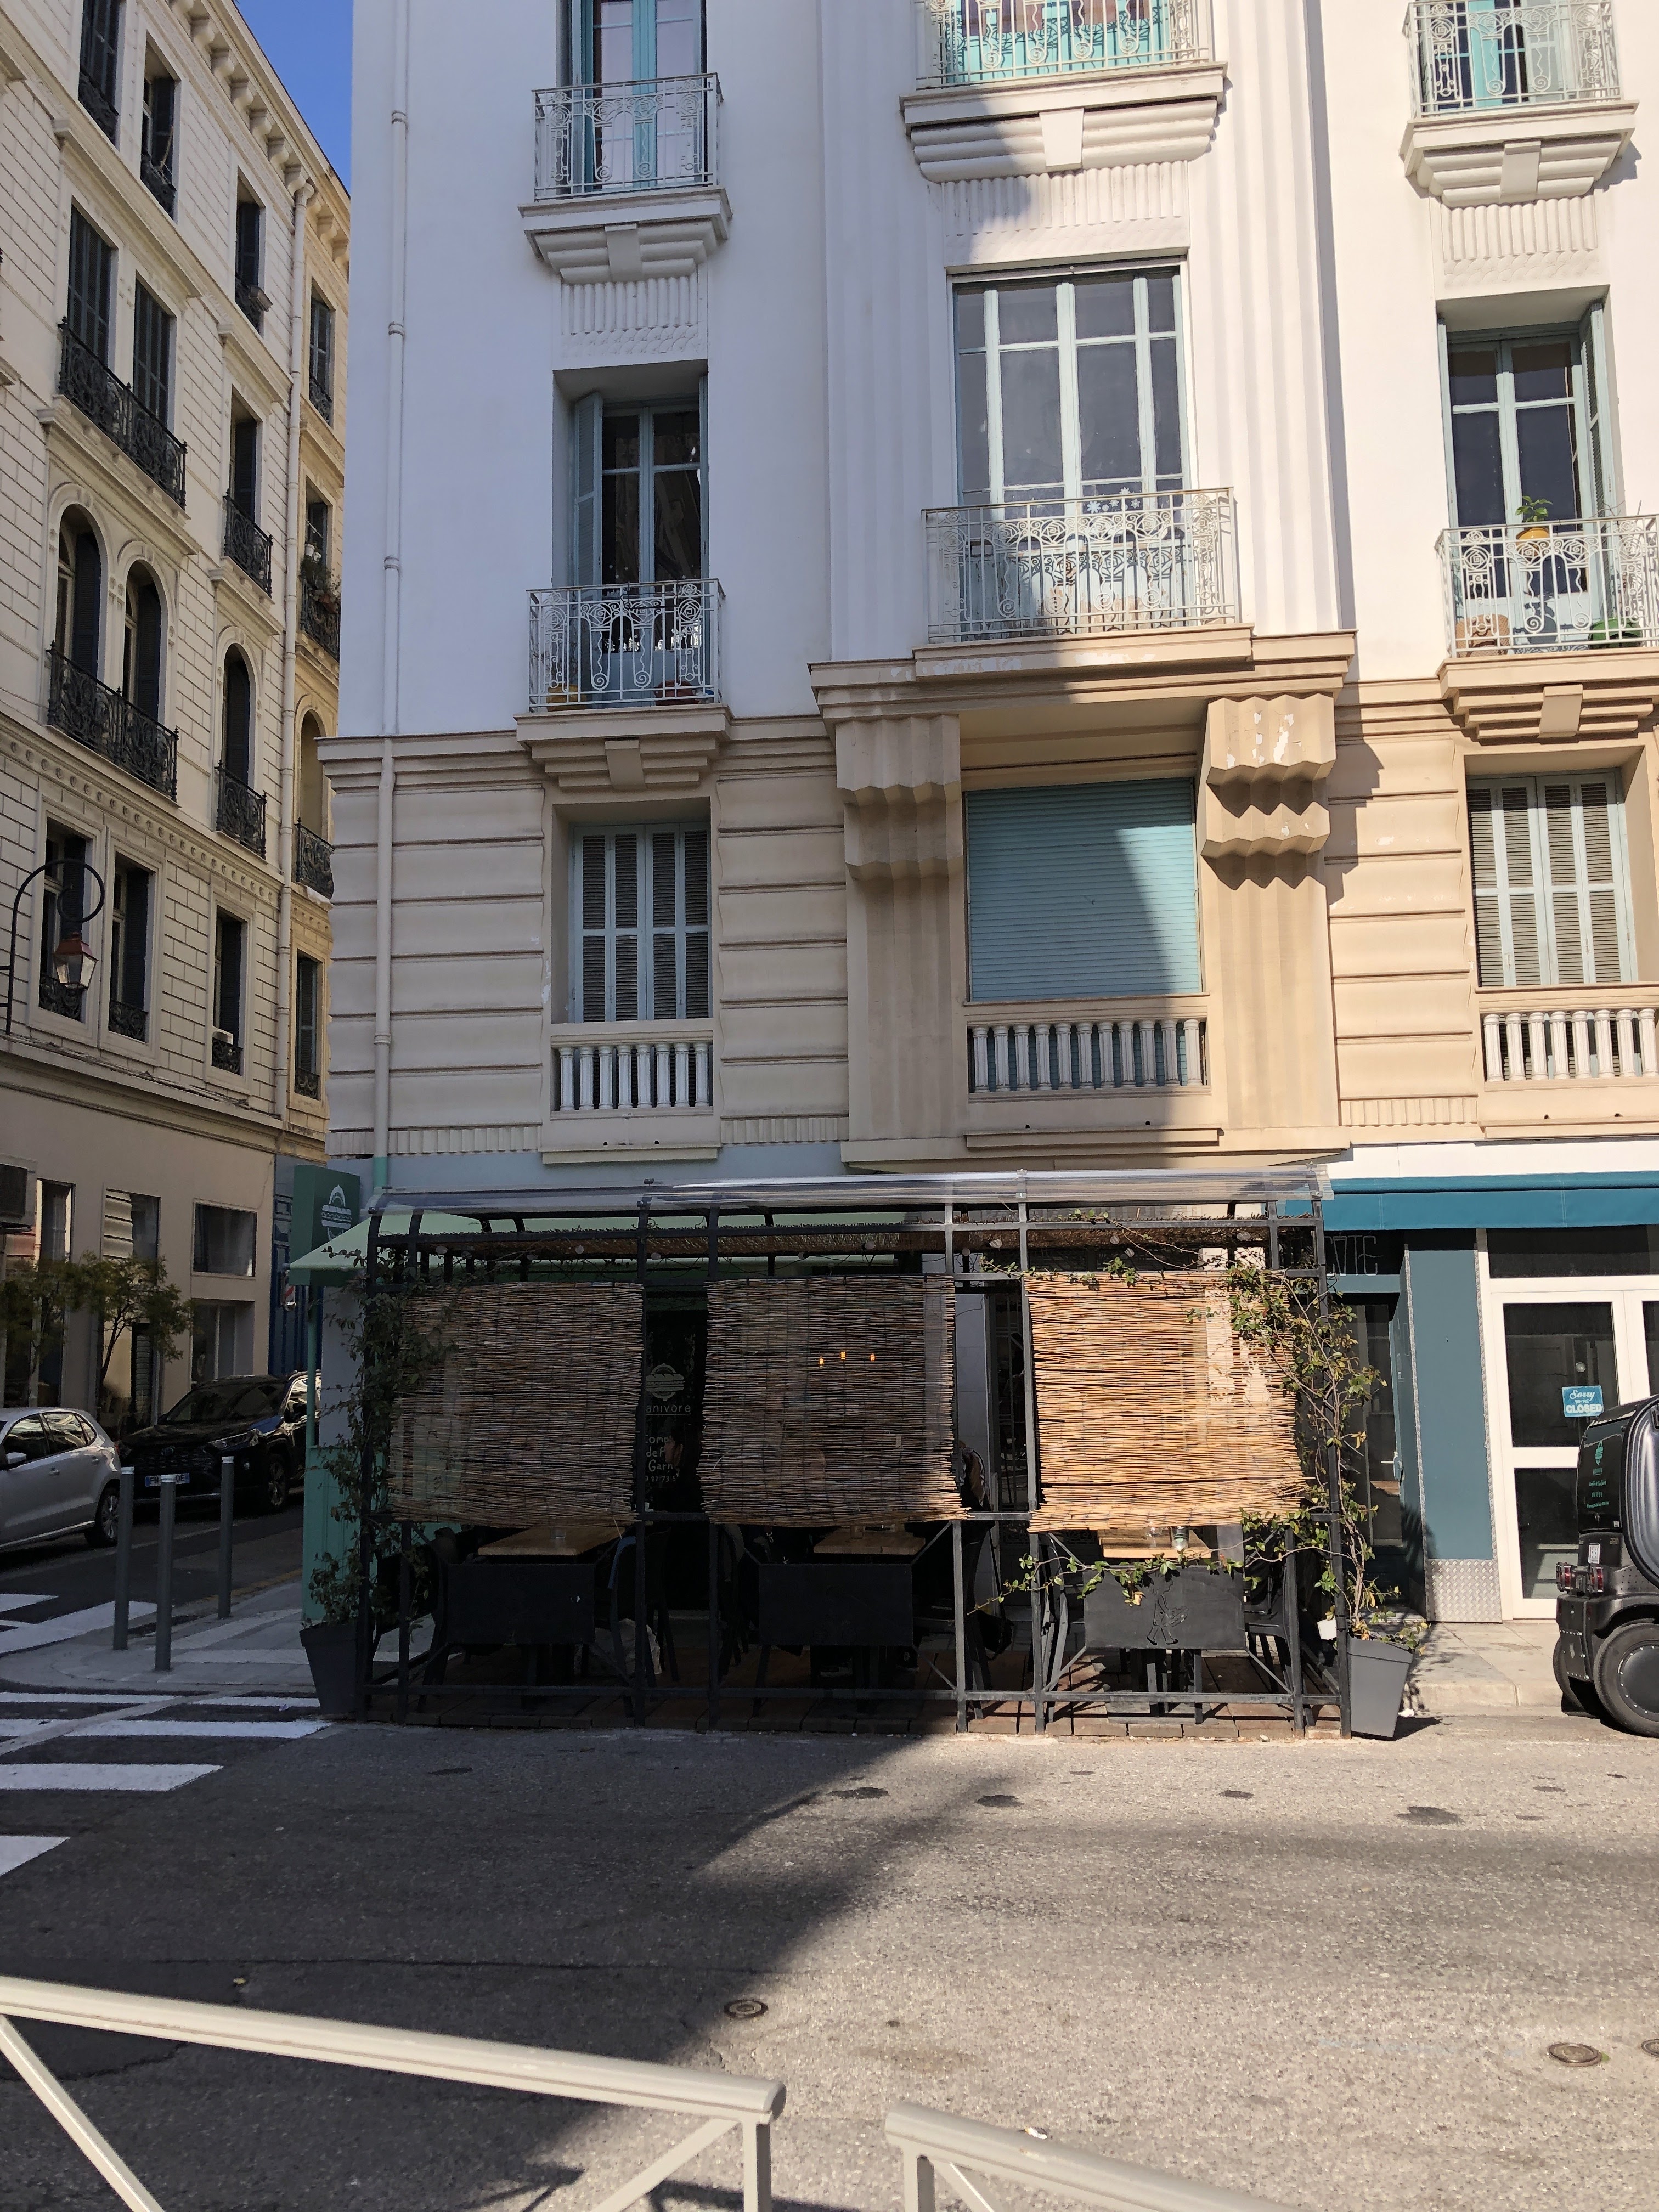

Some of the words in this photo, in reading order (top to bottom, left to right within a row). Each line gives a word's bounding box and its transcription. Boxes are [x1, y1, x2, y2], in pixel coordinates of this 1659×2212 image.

[1569, 1389, 1595, 1402] Sorry
[646, 1404, 691, 1413] anivore
[1566, 1403, 1602, 1414] CLOSED
